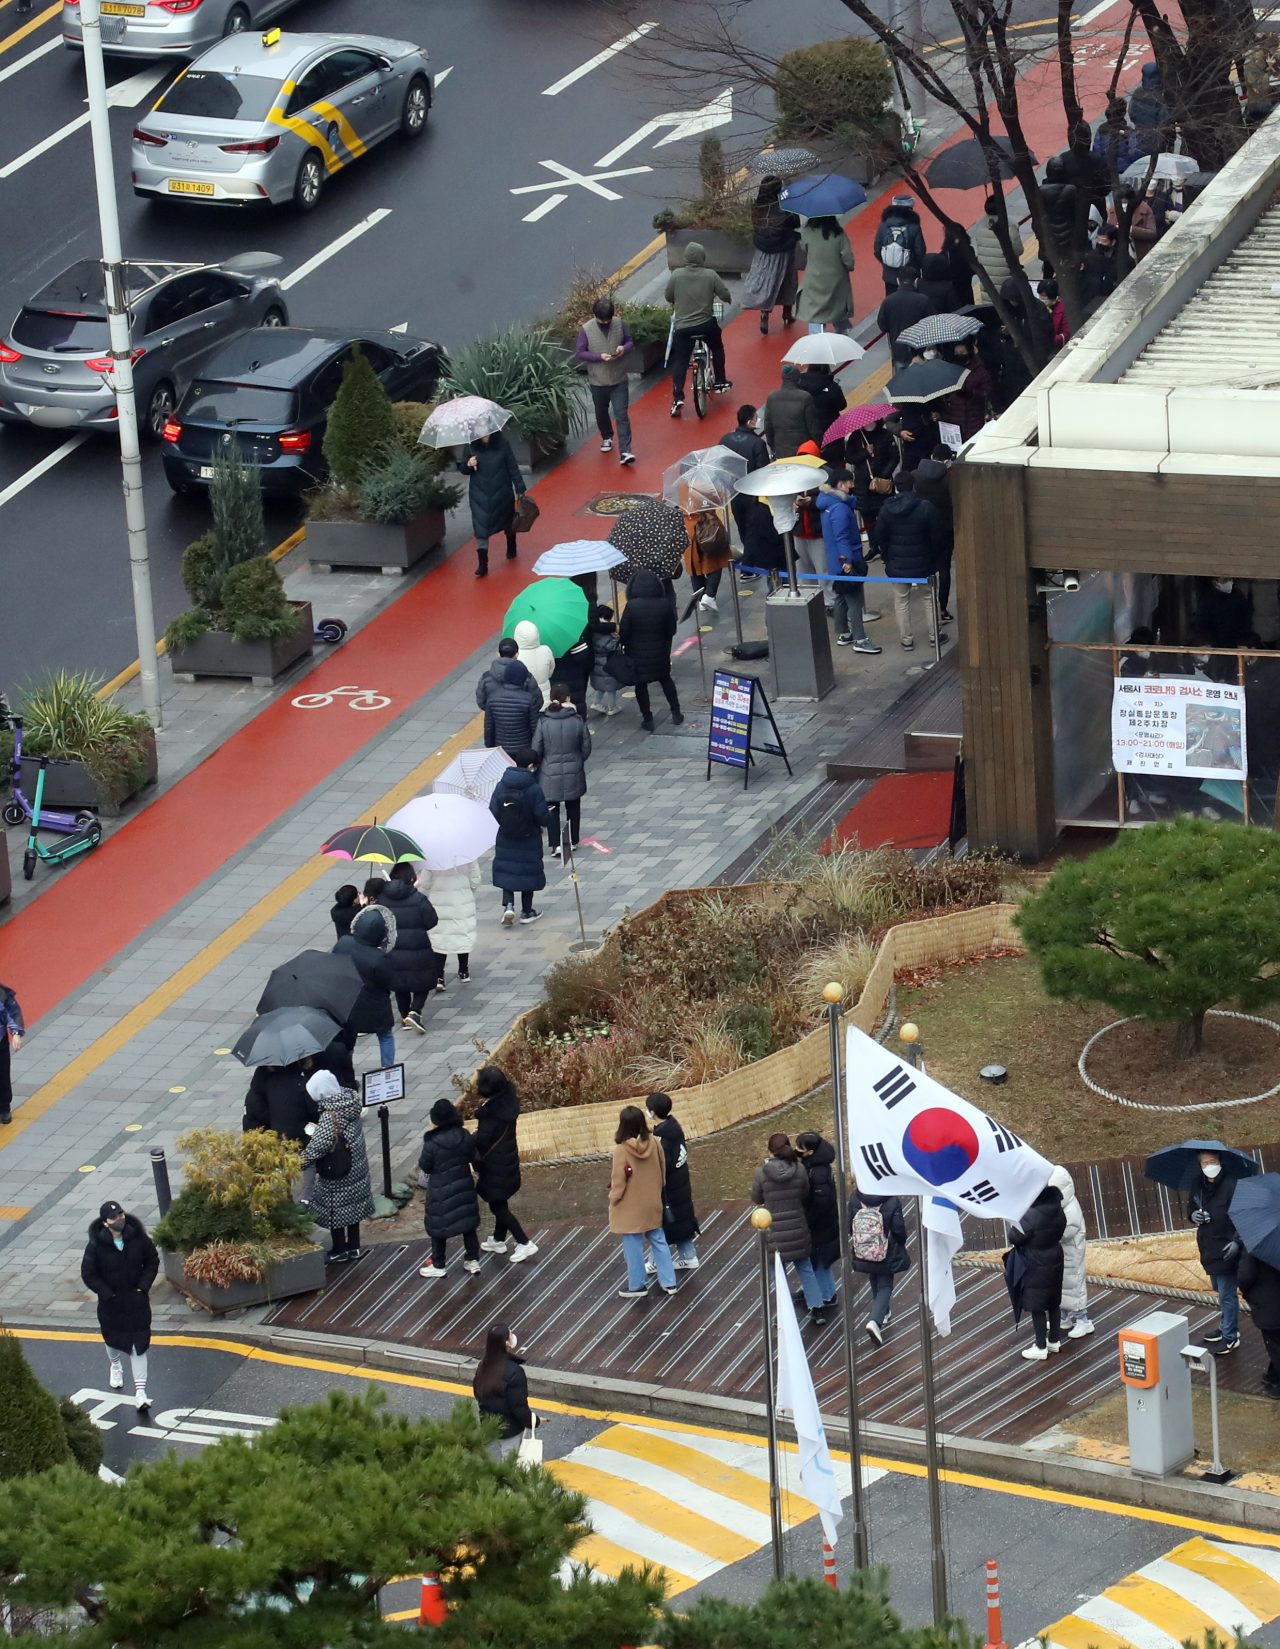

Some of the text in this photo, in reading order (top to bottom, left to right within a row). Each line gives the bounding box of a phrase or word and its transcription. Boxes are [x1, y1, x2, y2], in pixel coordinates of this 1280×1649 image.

[1118, 684, 1141, 694] 서울시
[1179, 686, 1204, 697] 검사소
[1205, 689, 1221, 698] 운영
[1224, 691, 1238, 700] 안내
[1129, 719, 1168, 728] 제2주차장
